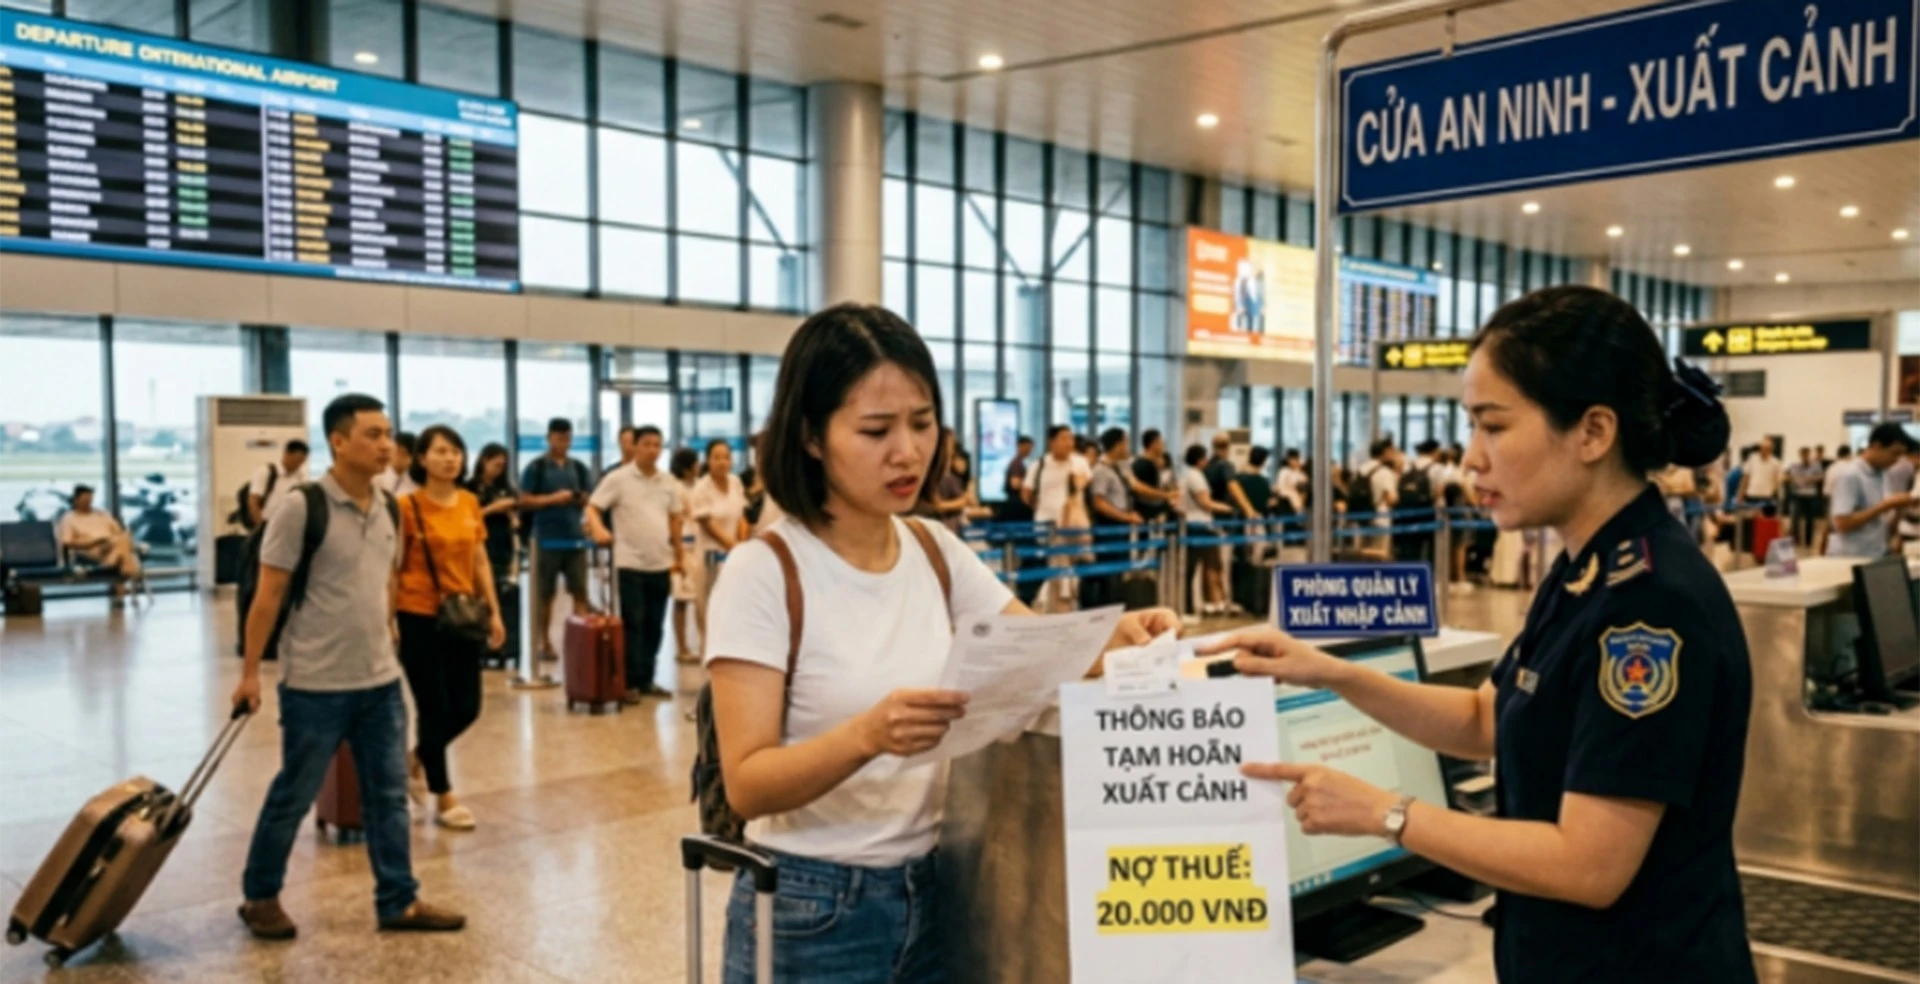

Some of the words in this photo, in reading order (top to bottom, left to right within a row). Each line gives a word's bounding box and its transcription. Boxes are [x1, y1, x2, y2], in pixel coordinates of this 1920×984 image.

[15, 22, 134, 58] DEPARTURE
[270, 68, 339, 93] AIRPORT
[1356, 85, 1427, 165] CỬA
[1435, 91, 1487, 153] AN
[1498, 72, 1591, 144] NINH
[1602, 96, 1616, 110] -
[1627, 23, 1747, 124] XUẤT
[1759, 4, 1897, 103] CẢNH
[1292, 572, 1349, 597] PHÒNG
[1351, 570, 1396, 598] QUẢN
[1288, 600, 1331, 627] XUẤT
[1334, 601, 1379, 630] NHẬP
[1383, 599, 1428, 626] CẢNH
[1095, 704, 1185, 731] THÔNG
[1192, 702, 1246, 730] BÁO
[1103, 745, 1161, 772] TẠM
[1168, 738, 1242, 766] HOÃN
[1103, 774, 1171, 804] XUẤT
[1176, 772, 1248, 803] CẢNH
[1109, 855, 1158, 888] NỢ
[1163, 843, 1252, 881] THUẾ:
[1097, 899, 1195, 926] 20.000
[1201, 898, 1268, 924] VNĐ
